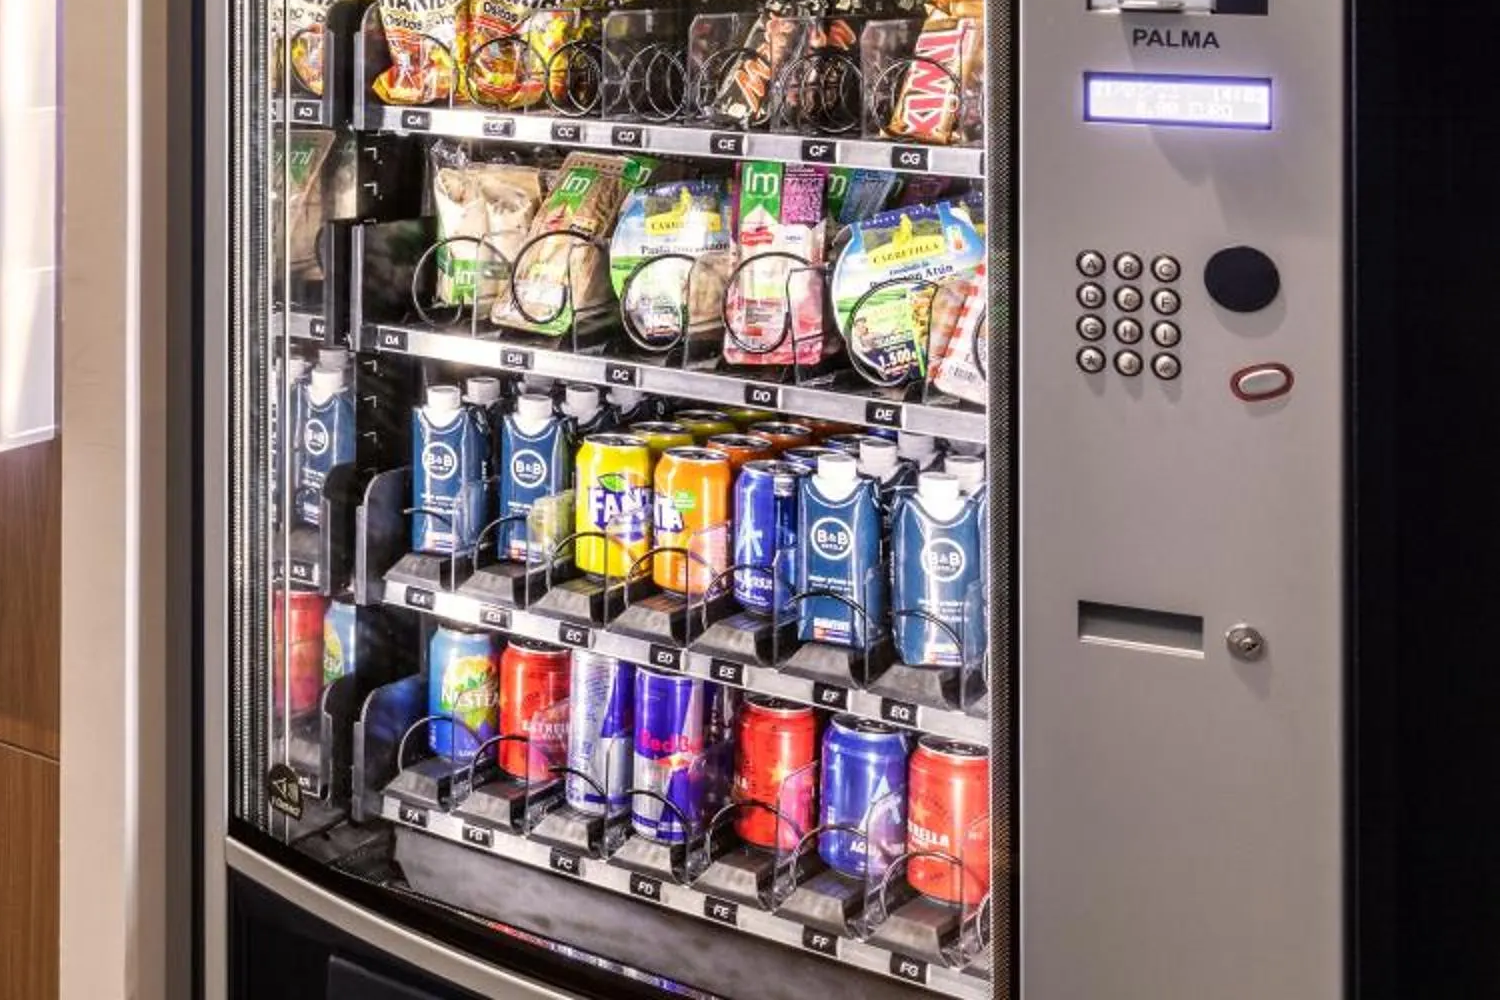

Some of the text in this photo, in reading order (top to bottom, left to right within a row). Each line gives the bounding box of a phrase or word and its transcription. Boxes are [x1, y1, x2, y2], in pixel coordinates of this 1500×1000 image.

[1132, 28, 1220, 49] PALMA
[617, 130, 635, 141] CD
[717, 139, 736, 151] CE
[809, 144, 829, 157] CF
[900, 152, 921, 165] CG
[612, 368, 630, 381] DC
[875, 408, 895, 421] DE
[427, 453, 453, 467] B&B
[516, 460, 542, 475] B&B
[817, 529, 849, 546] B&B
[929, 551, 960, 567] B&B
[557, 857, 574, 870] FC
[637, 880, 654, 895] FD
[713, 905, 729, 919] FE
[811, 934, 830, 948] FF
[900, 962, 919, 978] FG
